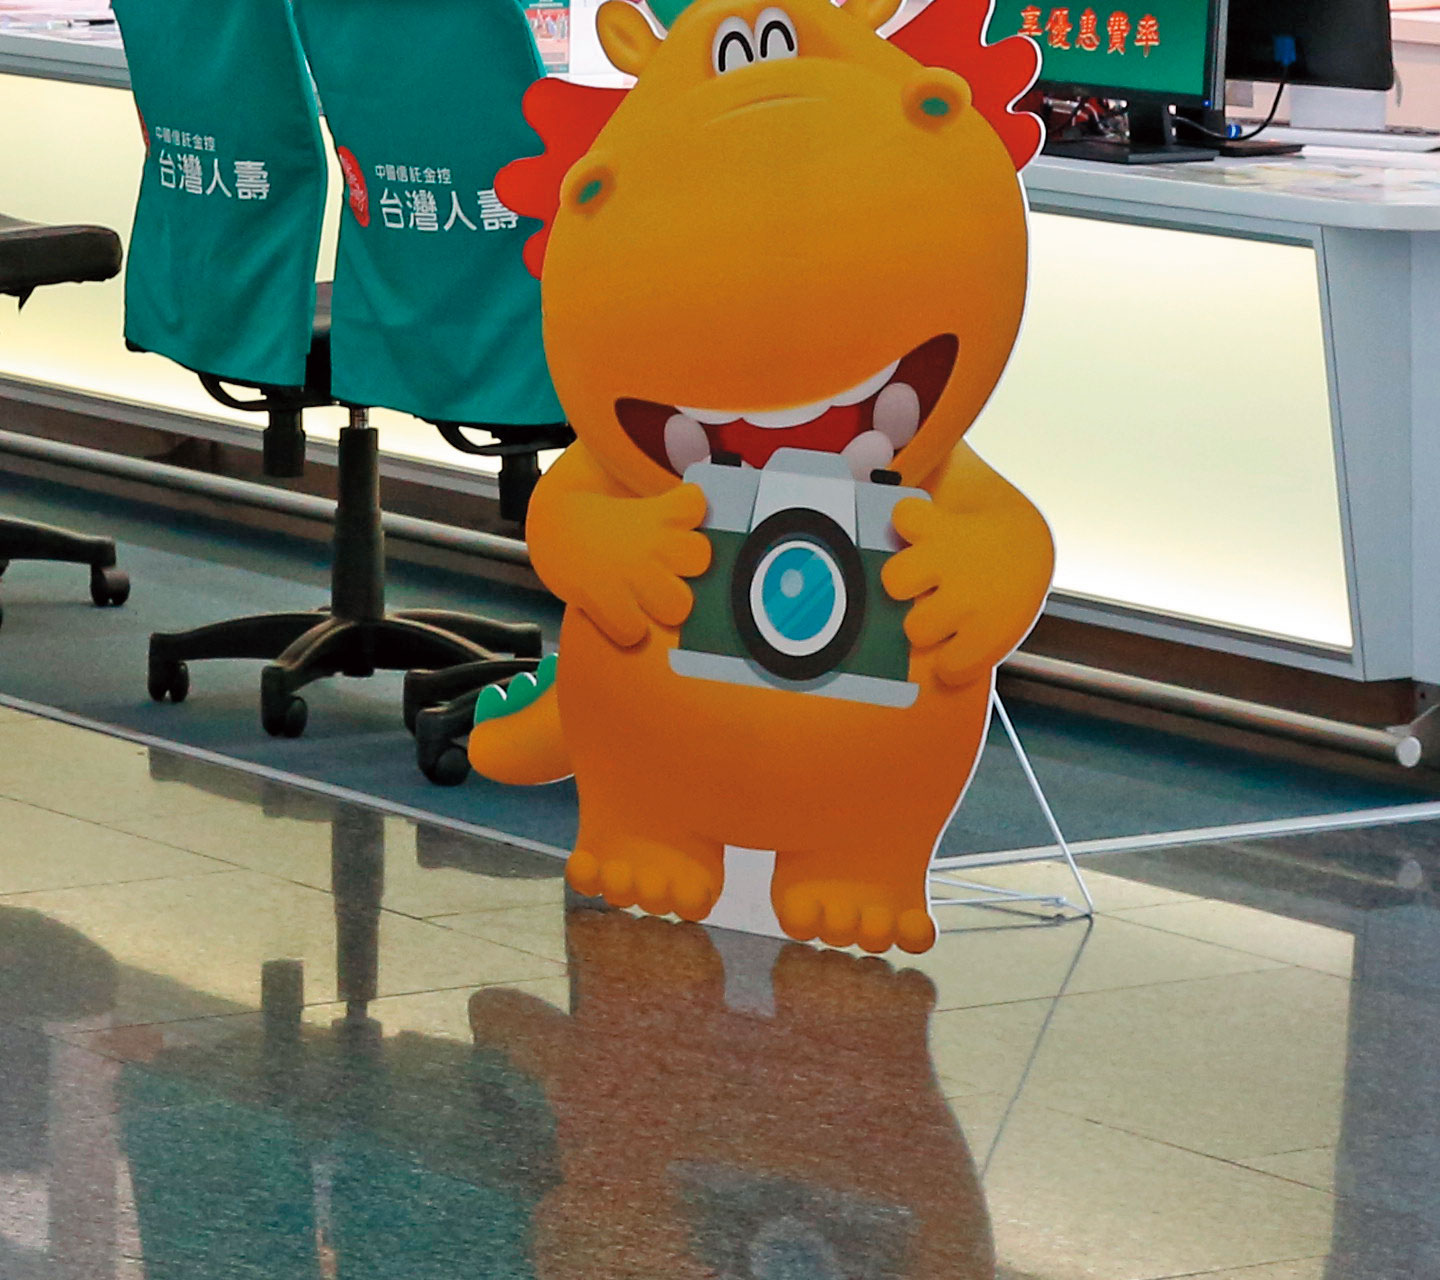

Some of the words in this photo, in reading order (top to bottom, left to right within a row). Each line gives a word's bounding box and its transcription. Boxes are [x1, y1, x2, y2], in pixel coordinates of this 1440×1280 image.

[1017, 4, 1161, 59] 享優惠費率
[158, 149, 271, 201] 台灣人壽
[374, 164, 453, 185] 中國信託金控
[379, 187, 520, 232] 台灣人壽
